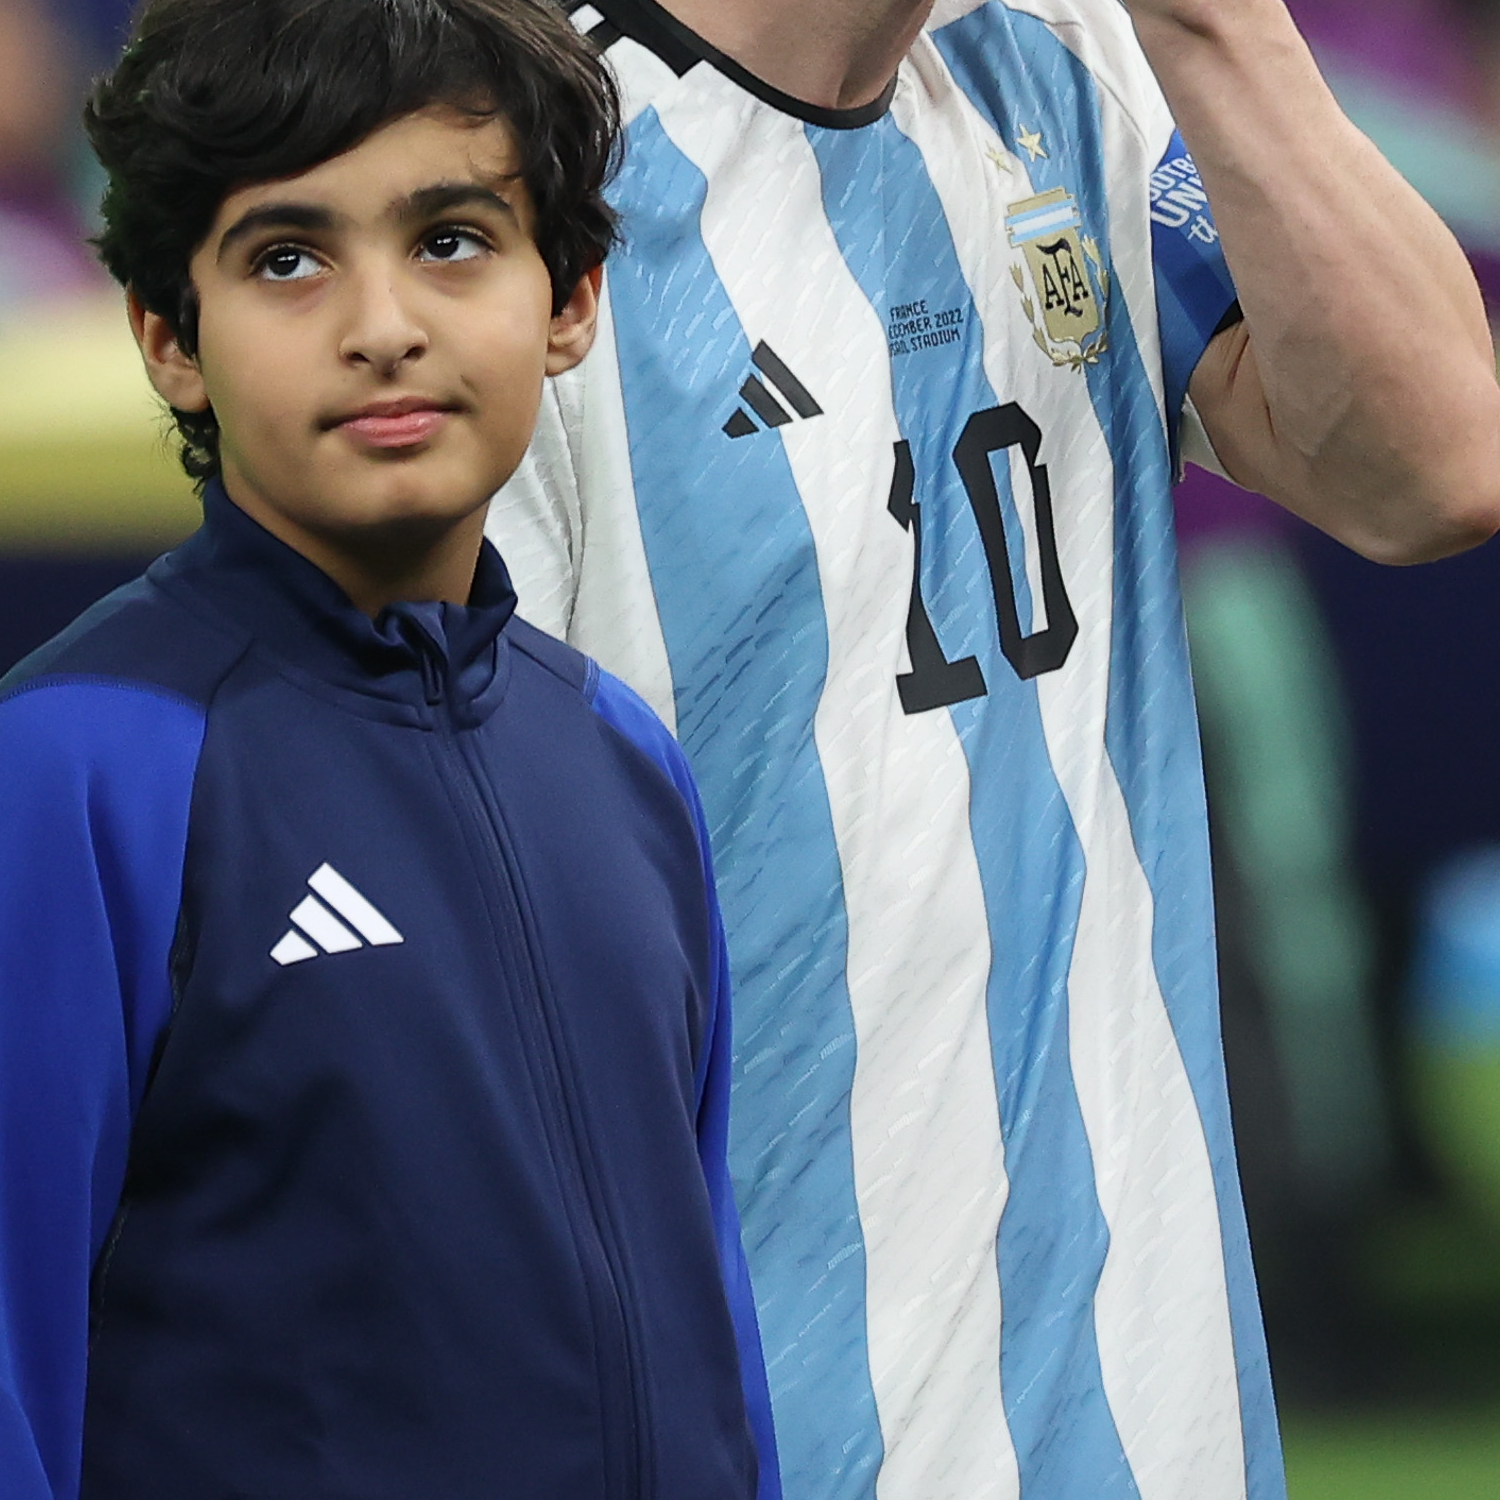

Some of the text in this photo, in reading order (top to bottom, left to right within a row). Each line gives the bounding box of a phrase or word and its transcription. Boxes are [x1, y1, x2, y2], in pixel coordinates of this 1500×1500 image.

[1036, 238, 1089, 317] AFA
[888, 307, 964, 339] ECEMBER 2022
[890, 299, 928, 322] FRANCE
[910, 327, 961, 351] STADIUM
[887, 401, 1079, 716] 10
